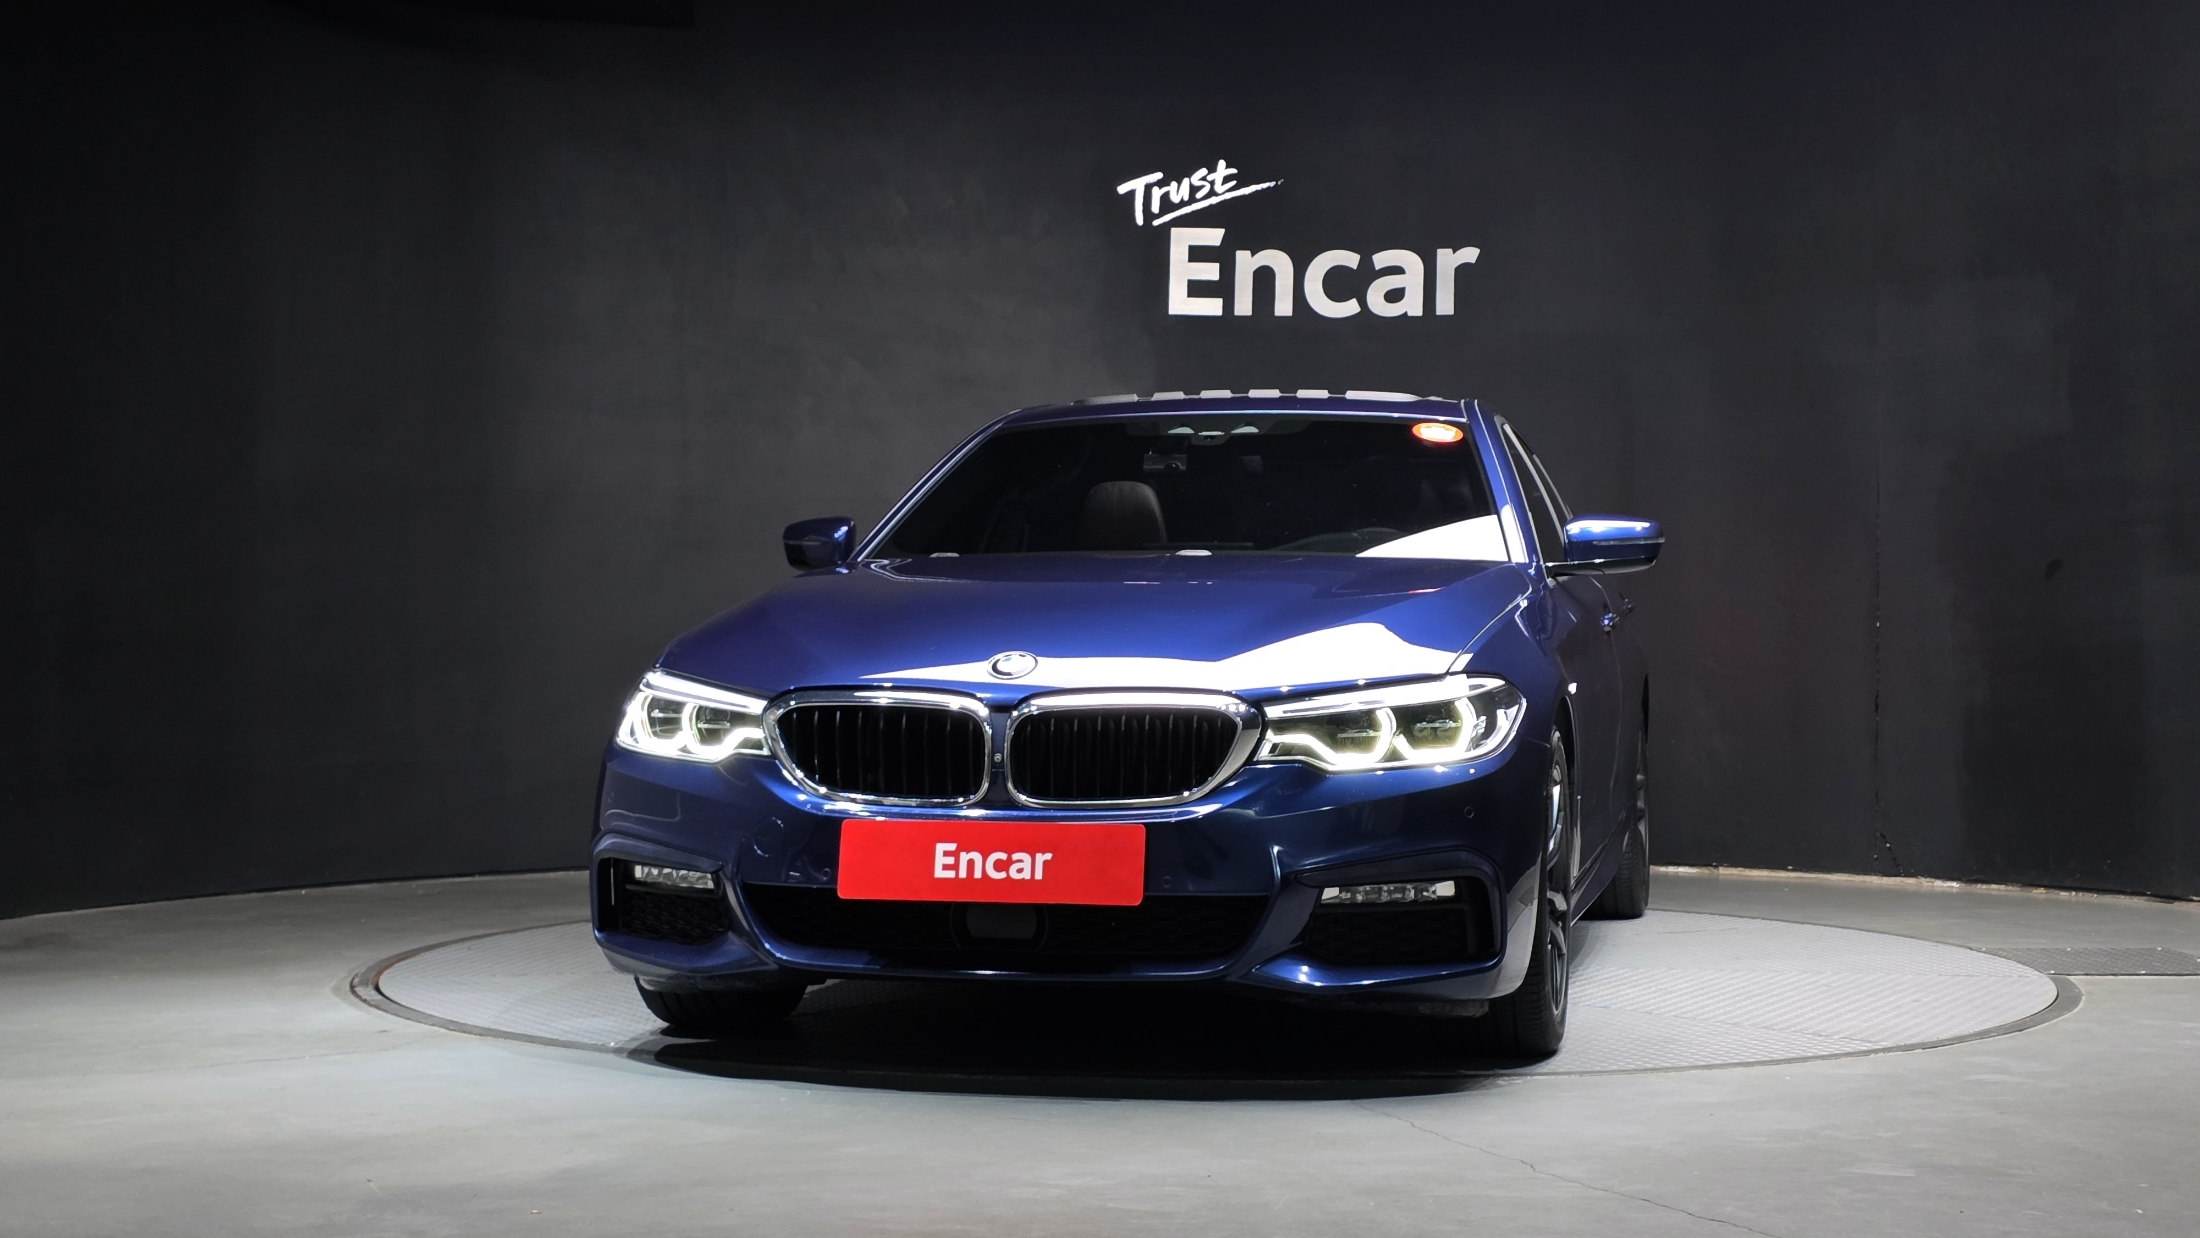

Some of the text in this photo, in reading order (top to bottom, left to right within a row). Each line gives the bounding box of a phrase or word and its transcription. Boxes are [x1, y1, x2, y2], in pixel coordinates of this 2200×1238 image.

[1117, 159, 1240, 226] Trust
[1168, 227, 1480, 318] Encar
[933, 842, 1053, 880] Encar
